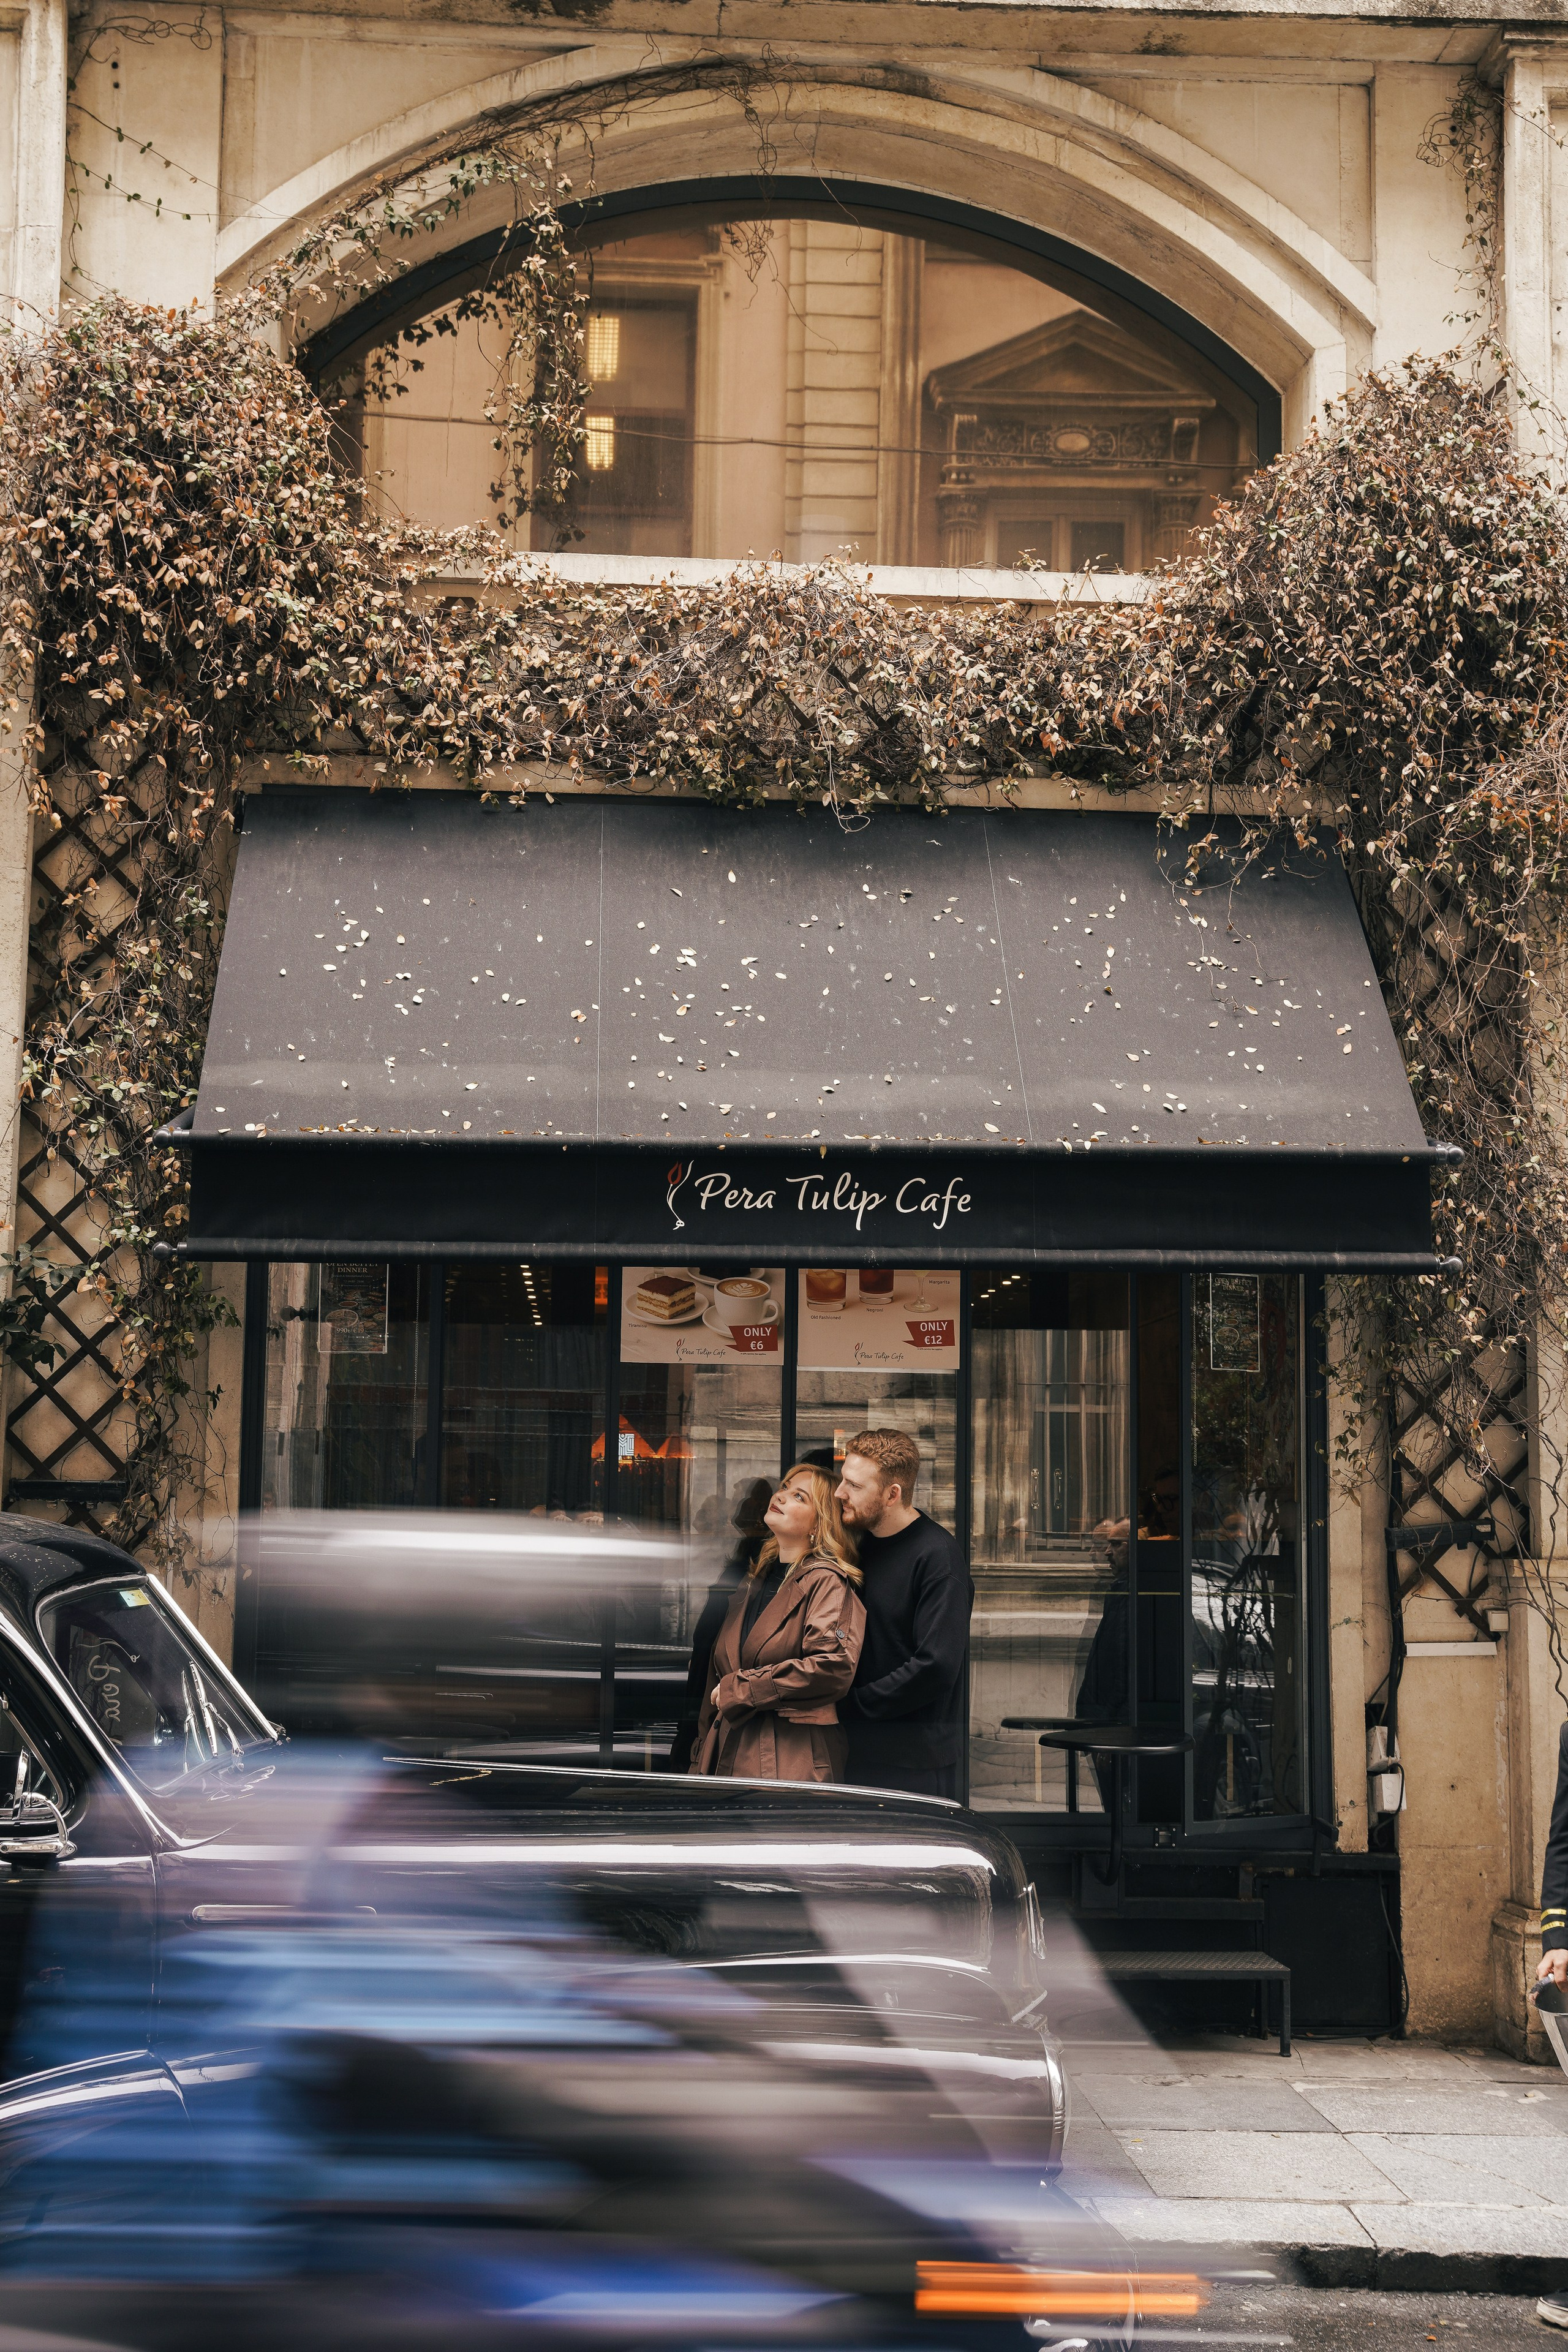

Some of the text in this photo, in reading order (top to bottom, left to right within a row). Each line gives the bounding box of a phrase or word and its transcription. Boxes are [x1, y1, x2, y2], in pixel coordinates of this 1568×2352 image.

[694, 1172, 971, 1231] Pera Tulip Cafe
[920, 1321, 948, 1332] ONLY
[744, 1327, 772, 1337] ONLY
[924, 1335, 943, 1344] €12
[750, 1341, 764, 1350] €6
[696, 1348, 712, 1358] Tulip
[713, 1349, 726, 1359] Cafe
[874, 1352, 890, 1362] Tulip
[891, 1352, 904, 1362] Cafe
